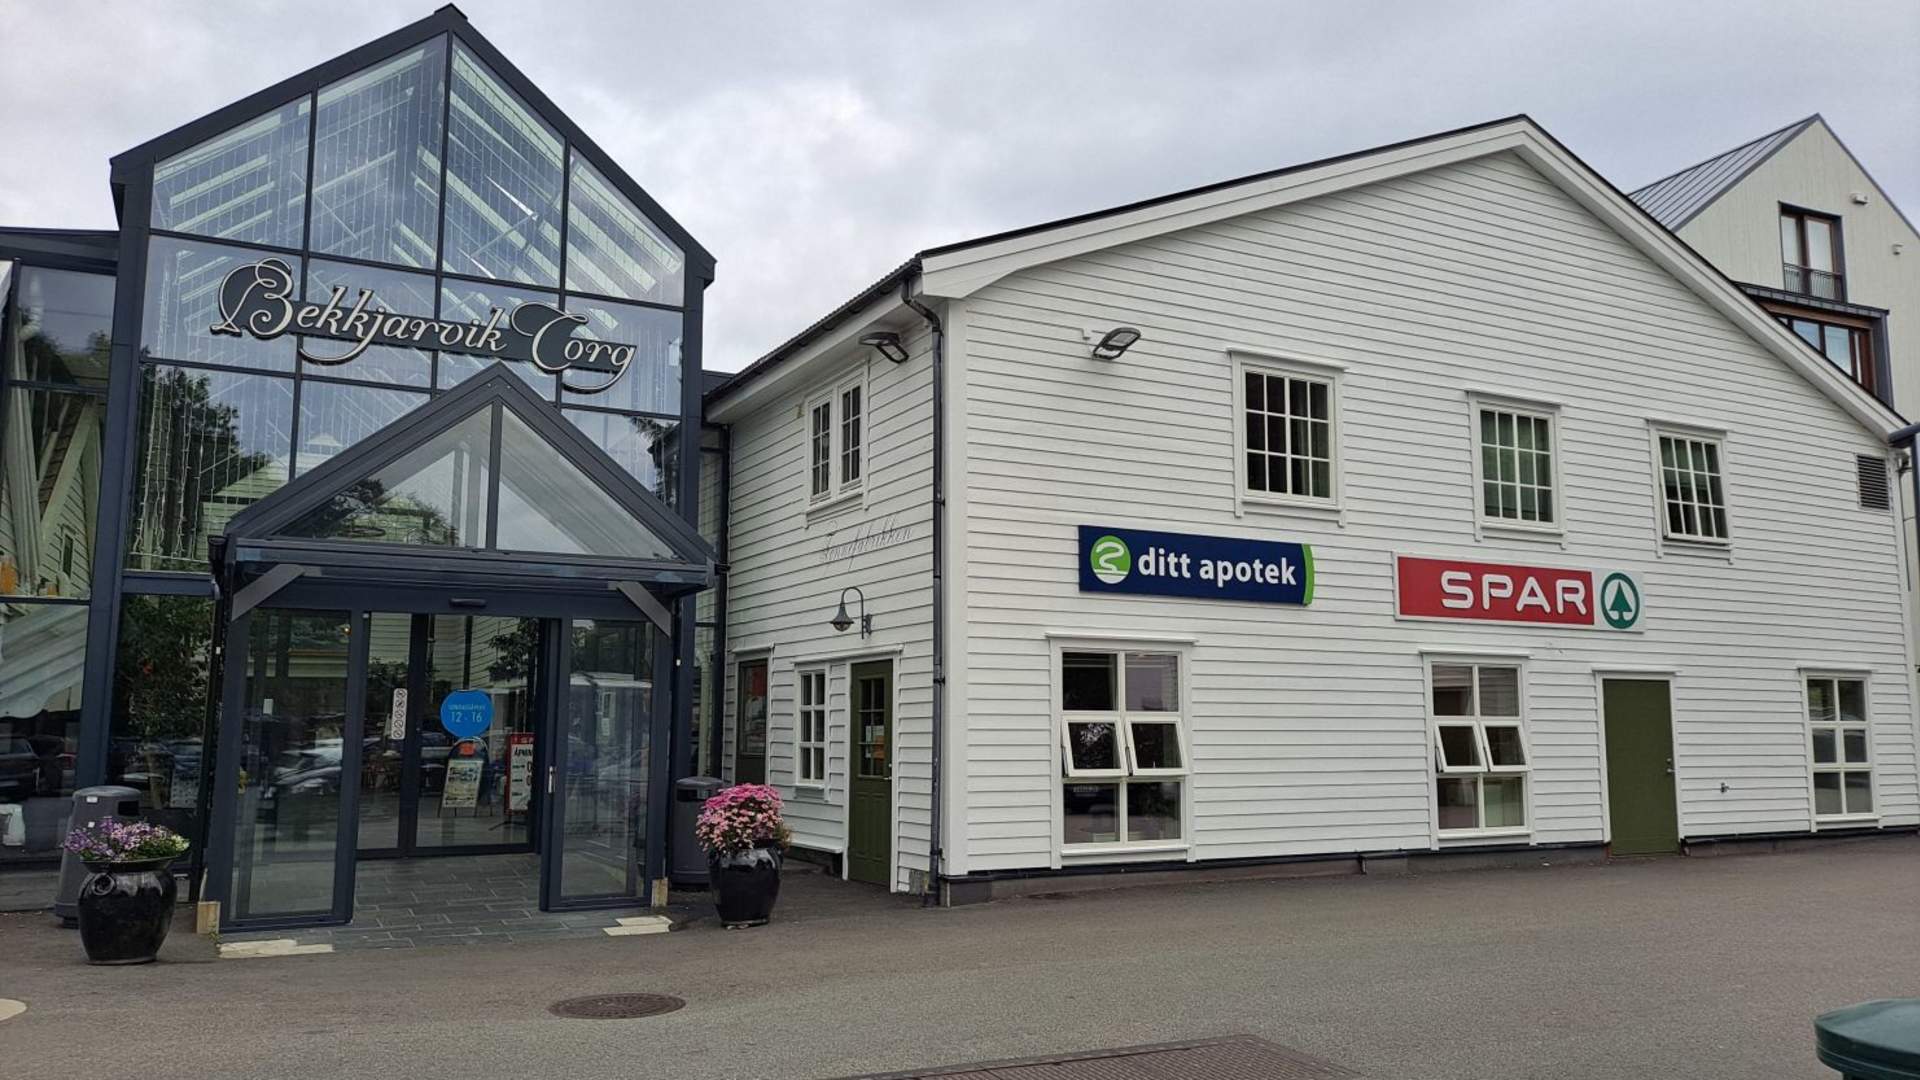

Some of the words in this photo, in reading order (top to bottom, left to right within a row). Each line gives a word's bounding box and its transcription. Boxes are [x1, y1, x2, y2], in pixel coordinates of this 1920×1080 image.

[210, 257, 507, 367] Bekkjarvik
[510, 301, 638, 394] Torg
[1137, 547, 1191, 578] ditt
[1200, 557, 1297, 588] apotek
[1440, 570, 1587, 616] SPAR
[451, 711, 463, 723] 12
[472, 711, 482, 723] 16
